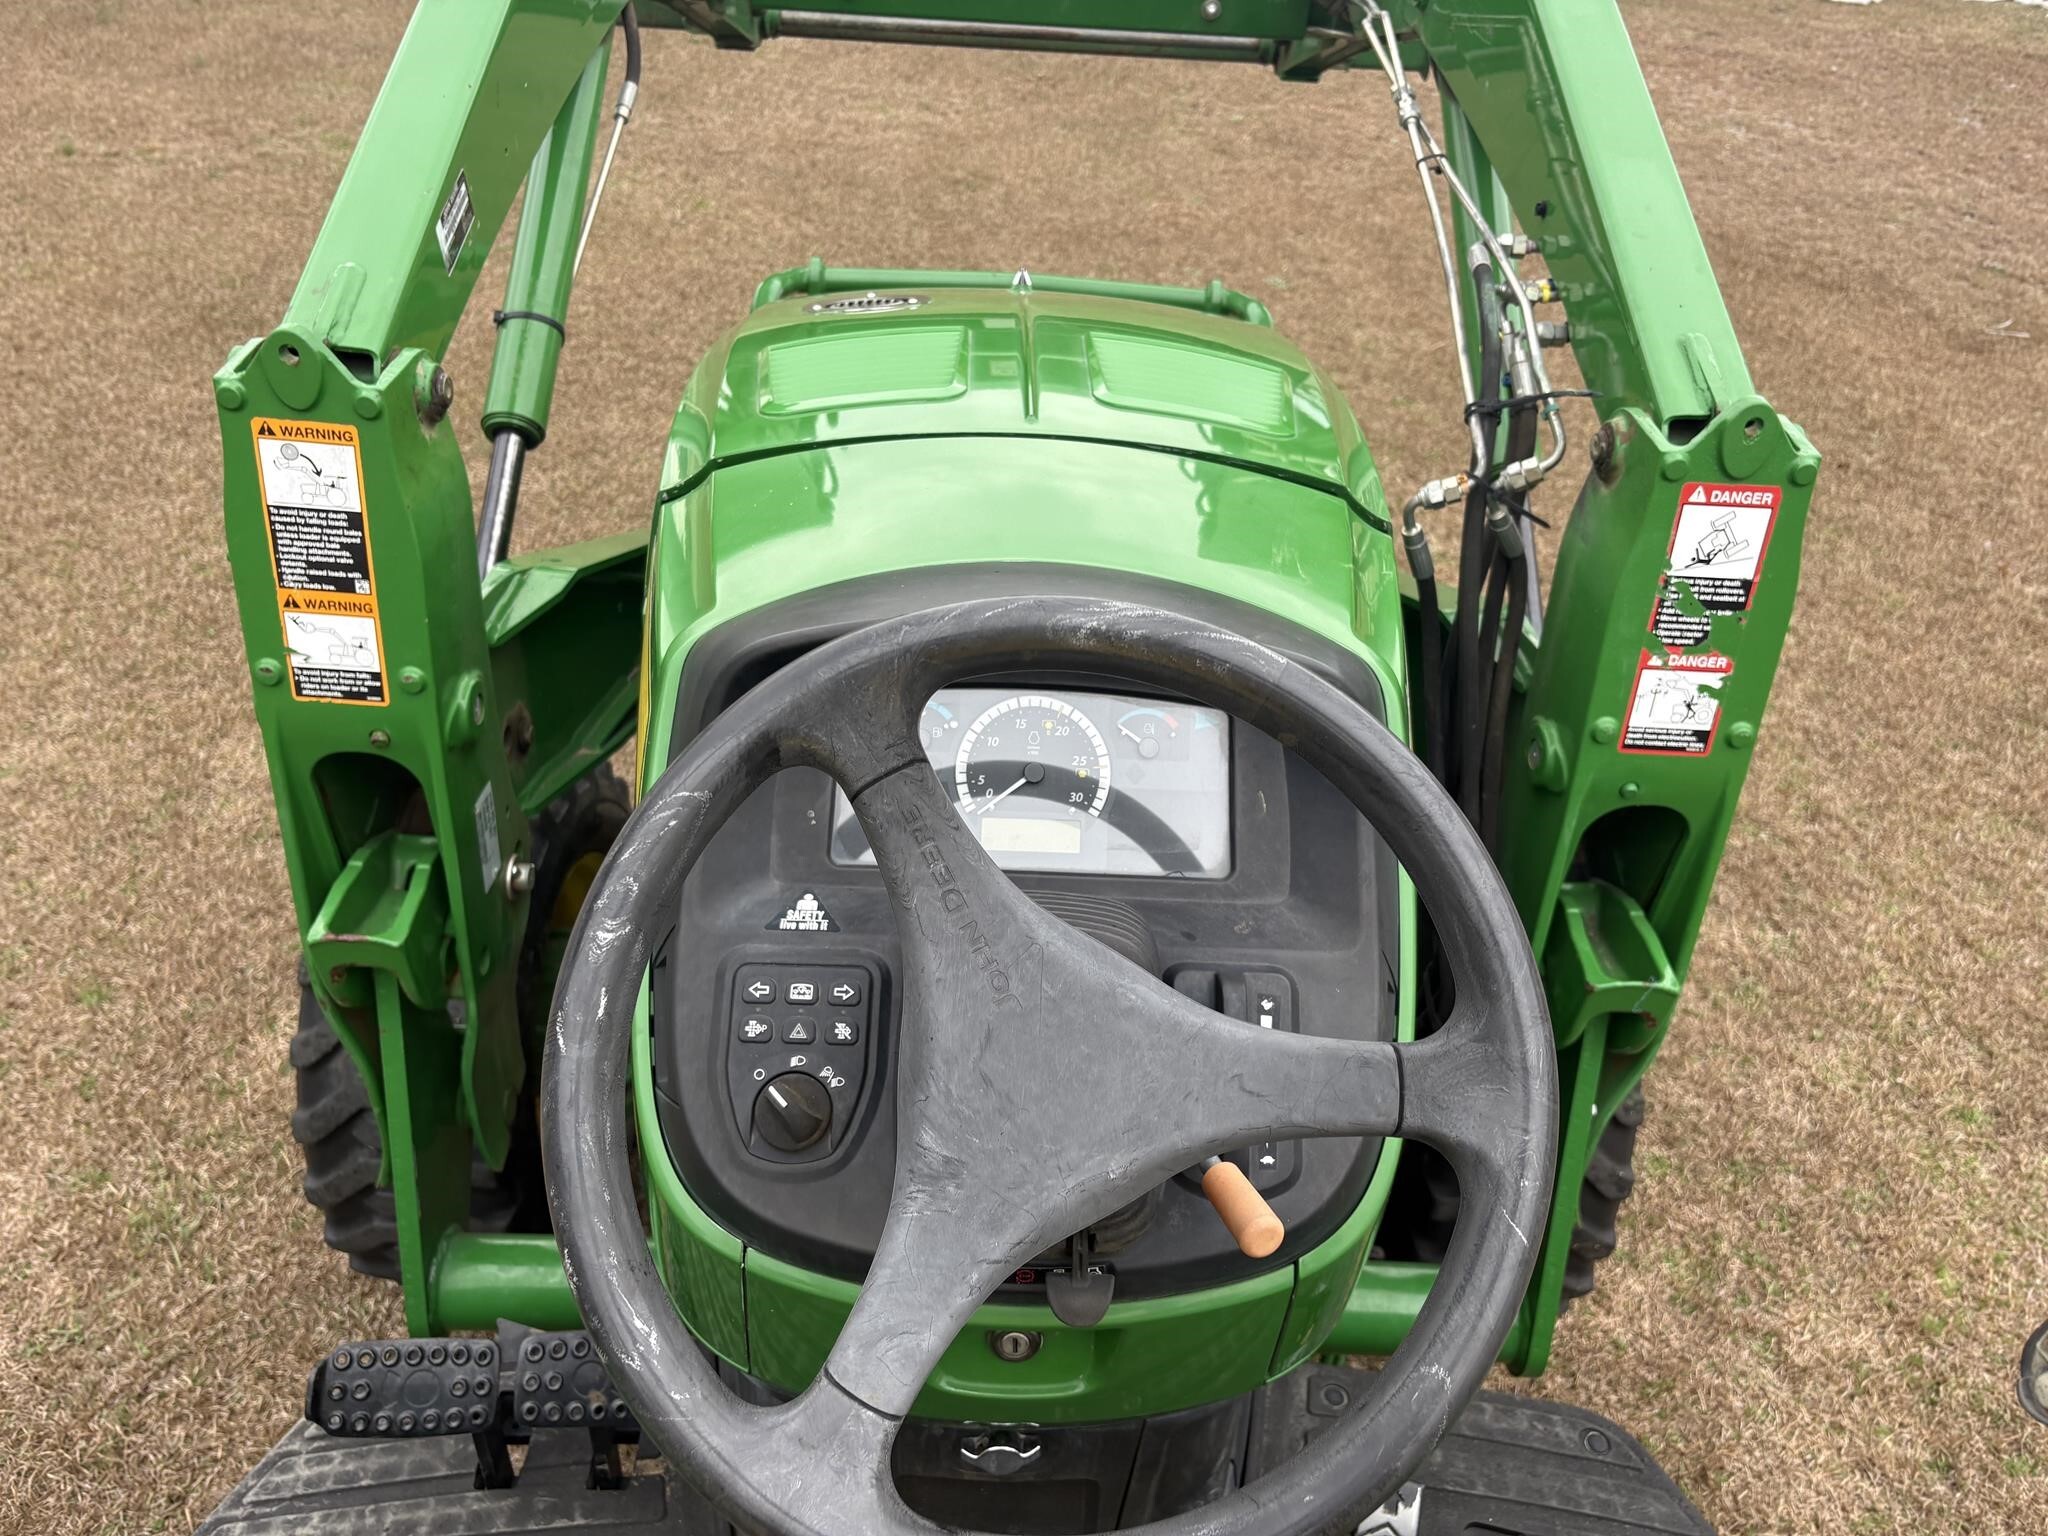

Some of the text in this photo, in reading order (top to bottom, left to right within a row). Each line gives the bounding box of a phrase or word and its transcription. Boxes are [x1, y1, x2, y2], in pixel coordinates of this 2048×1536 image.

[279, 425, 354, 442] WARNING
[1710, 490, 1774, 505] DANGER
[280, 508, 297, 516] avoid
[299, 509, 317, 519] injury
[271, 515, 295, 523] caused
[296, 516, 305, 524] by
[306, 518, 327, 527] falling
[299, 525, 322, 533] handle
[323, 528, 343, 536] round
[344, 529, 362, 537] bales
[293, 540, 325, 548] approved
[326, 541, 341, 549] bale
[278, 546, 307, 554] handling
[280, 552, 307, 560] Lockout
[282, 566, 305, 574] Handle
[1695, 578, 1713, 587] injury
[1700, 586, 1715, 594] from
[304, 598, 373, 614] WARNING
[1667, 654, 1729, 668] DANGER
[1015, 719, 1027, 729] 15
[1055, 726, 1070, 736] 20
[987, 736, 1000, 747] 10
[1072, 756, 1087, 766] 25
[977, 775, 986, 785] 5
[985, 788, 994, 798] 0
[1069, 792, 1084, 802] 30
[900, 804, 1024, 1010] JOHN DEERE
[786, 909, 825, 921] SAFETY
[779, 918, 829, 931] live with it
